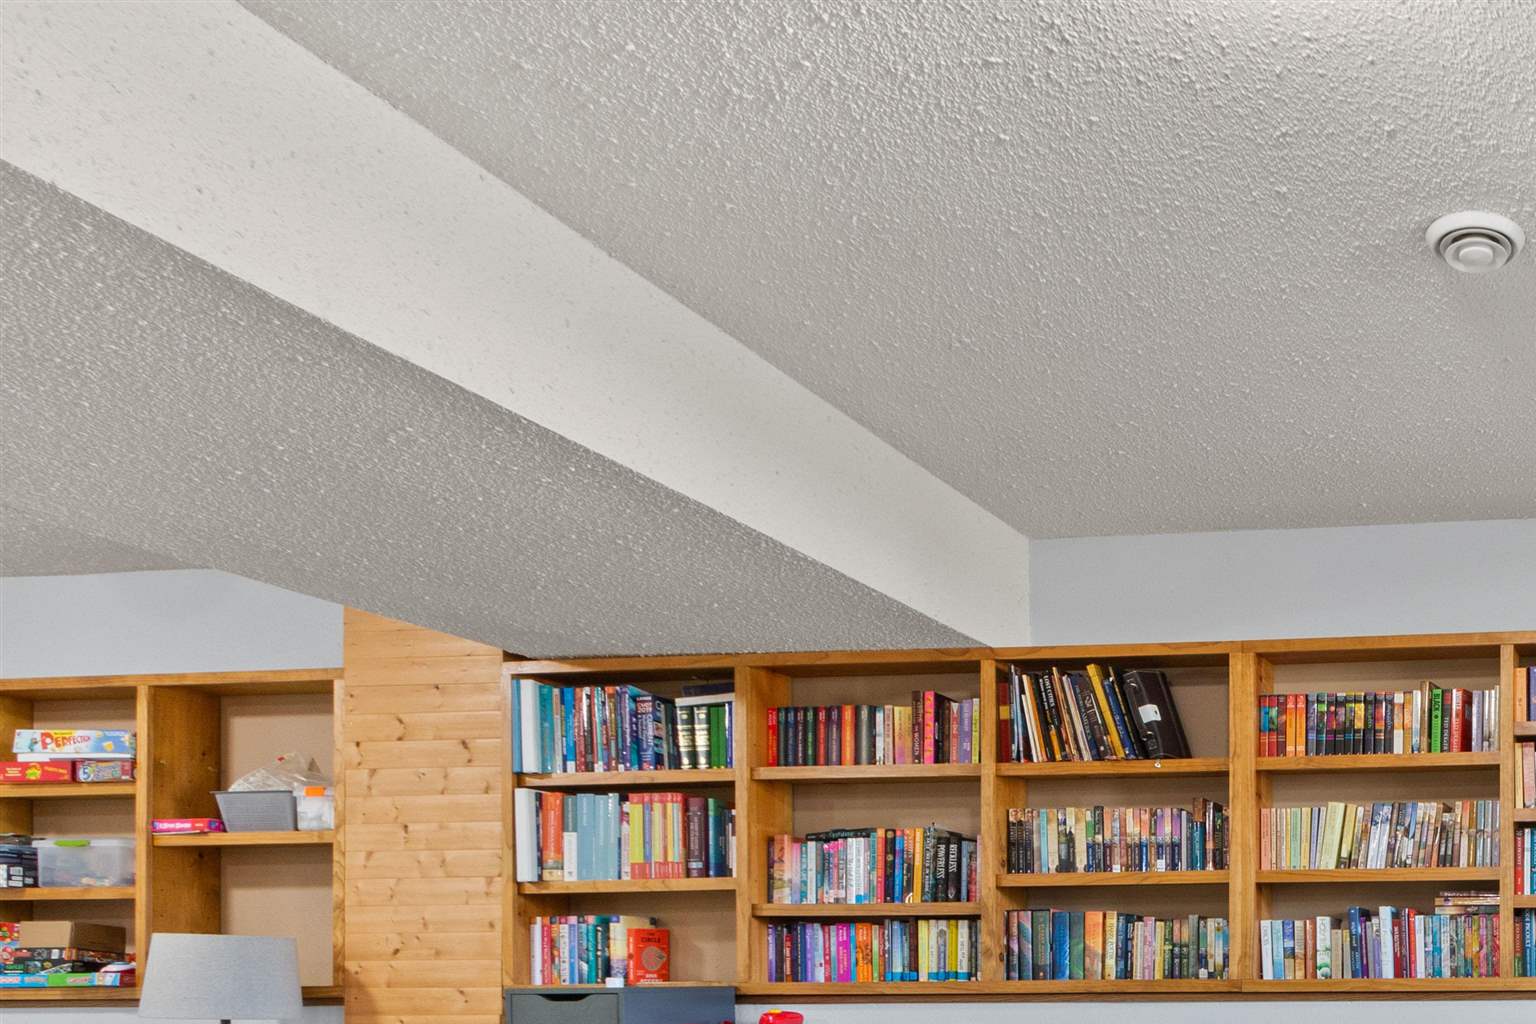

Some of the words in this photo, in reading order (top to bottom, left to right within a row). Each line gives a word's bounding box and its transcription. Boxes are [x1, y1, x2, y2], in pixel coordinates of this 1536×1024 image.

[1433, 693, 1441, 711] BLACK
[937, 844, 945, 879] POWERLESS
[949, 844, 958, 872] RECKLESS
